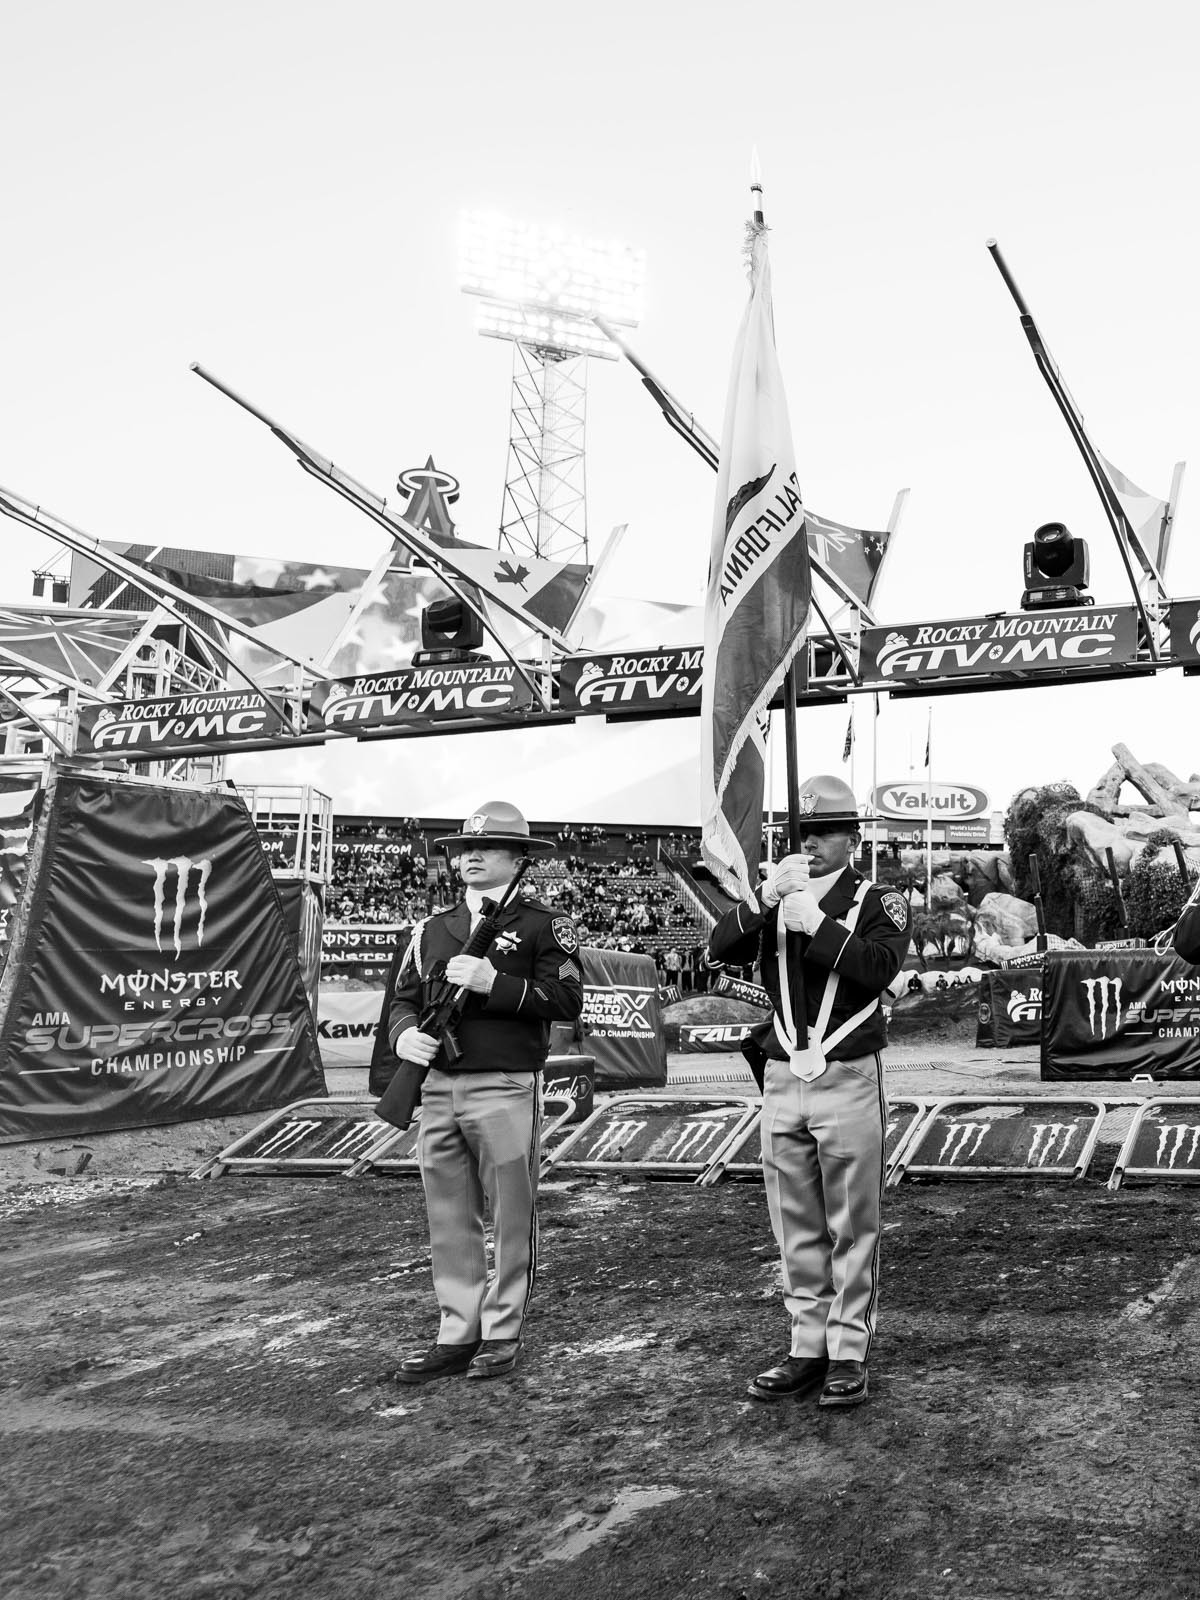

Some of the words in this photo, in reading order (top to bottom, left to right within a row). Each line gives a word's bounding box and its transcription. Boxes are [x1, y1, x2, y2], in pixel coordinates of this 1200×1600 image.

[912, 624, 988, 645] ROCKY
[989, 614, 1118, 639] MOUNTAIN
[607, 655, 675, 676] ROCKY
[350, 676, 409, 696] ROCKY
[409, 666, 516, 689] MOUNTAIN
[119, 703, 176, 721] ROCKY
[175, 694, 266, 716] MOUNTAIN
[890, 791, 971, 810] Yakult
[322, 931, 397, 947] ONSTER
[100, 968, 242, 997] MONSTER
[732, 982, 770, 1001] MONST
[124, 996, 222, 1011] ENERGY
[583, 992, 620, 1004] SUPER
[1129, 1001, 1147, 1010] AMA
[582, 1003, 620, 1014] MOTO
[32, 1012, 71, 1027] AMA
[580, 1013, 621, 1024] CROSS
[19, 1013, 294, 1053] SUPERCROSS
[607, 1030, 656, 1039] CHAMPIONSHIP
[91, 1046, 247, 1076] CHAMPIONSHIP
